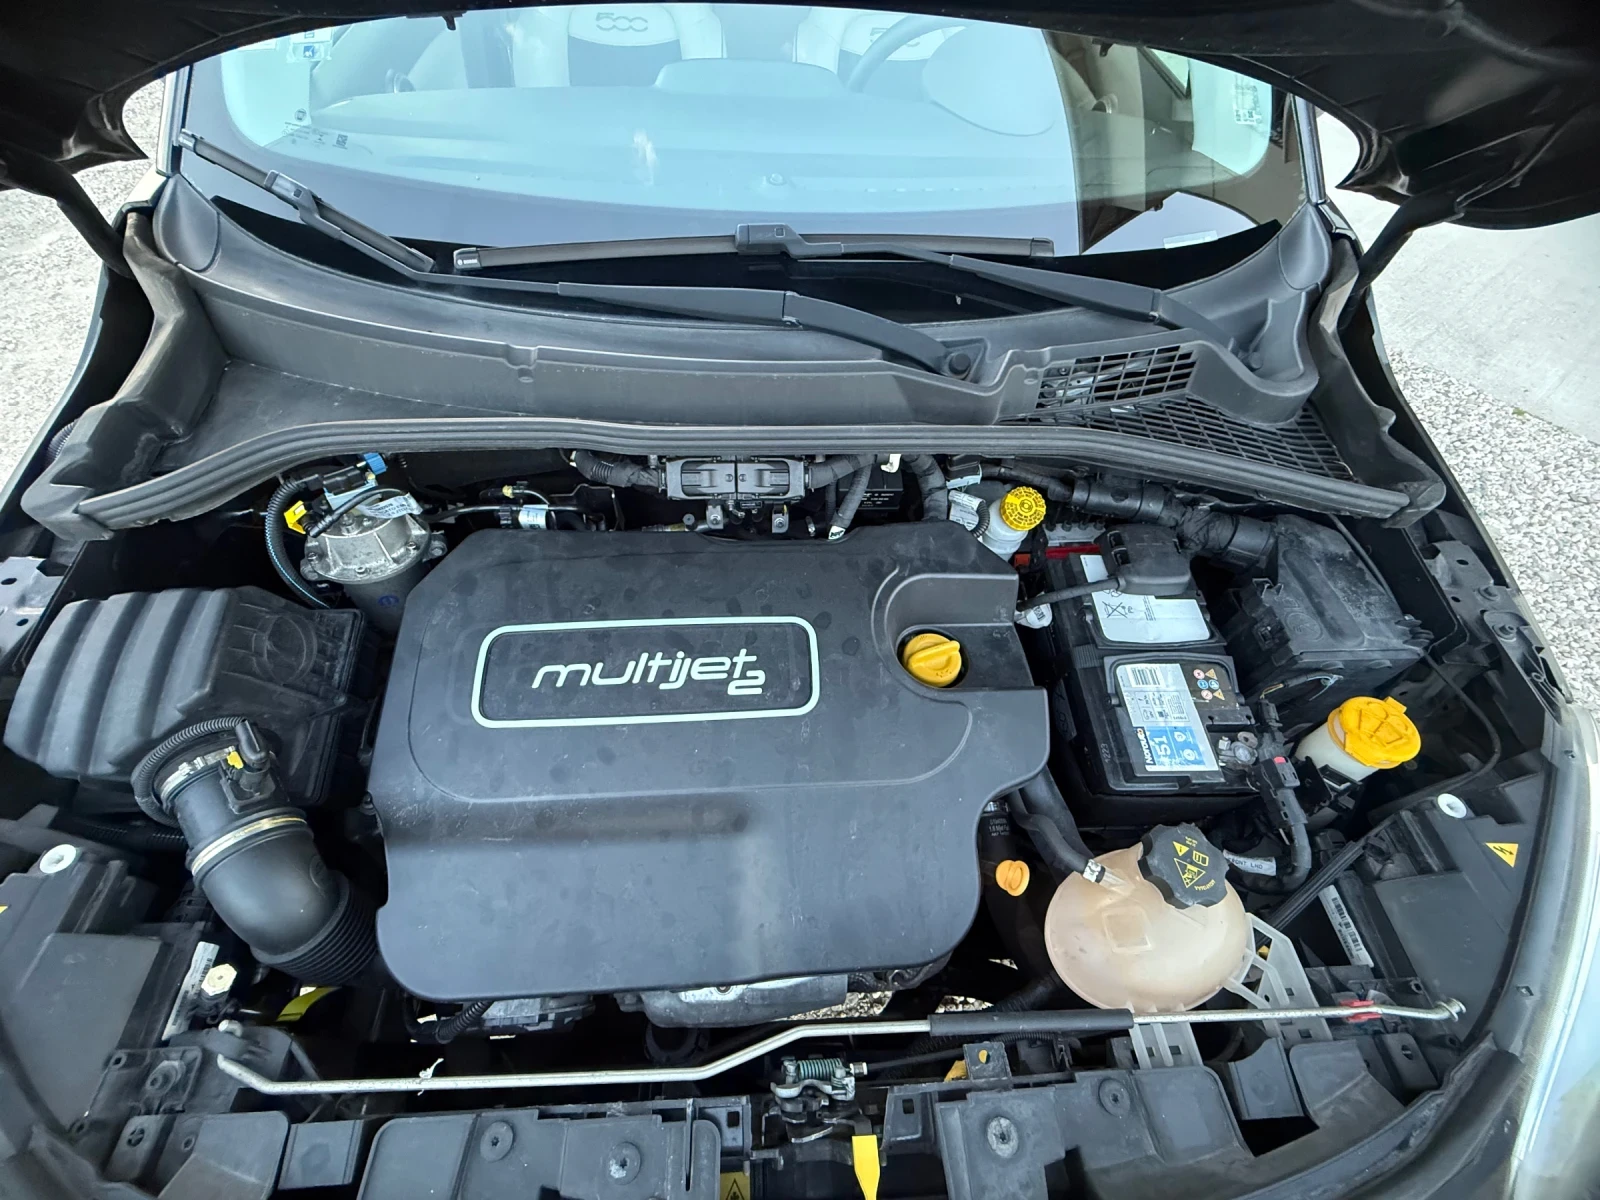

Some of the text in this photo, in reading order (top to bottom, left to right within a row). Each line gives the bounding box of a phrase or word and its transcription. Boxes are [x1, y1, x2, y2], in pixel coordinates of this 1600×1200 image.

[596, 12, 648, 32] 500
[531, 648, 766, 696] multijet 2
[1153, 735, 1171, 756] 51
